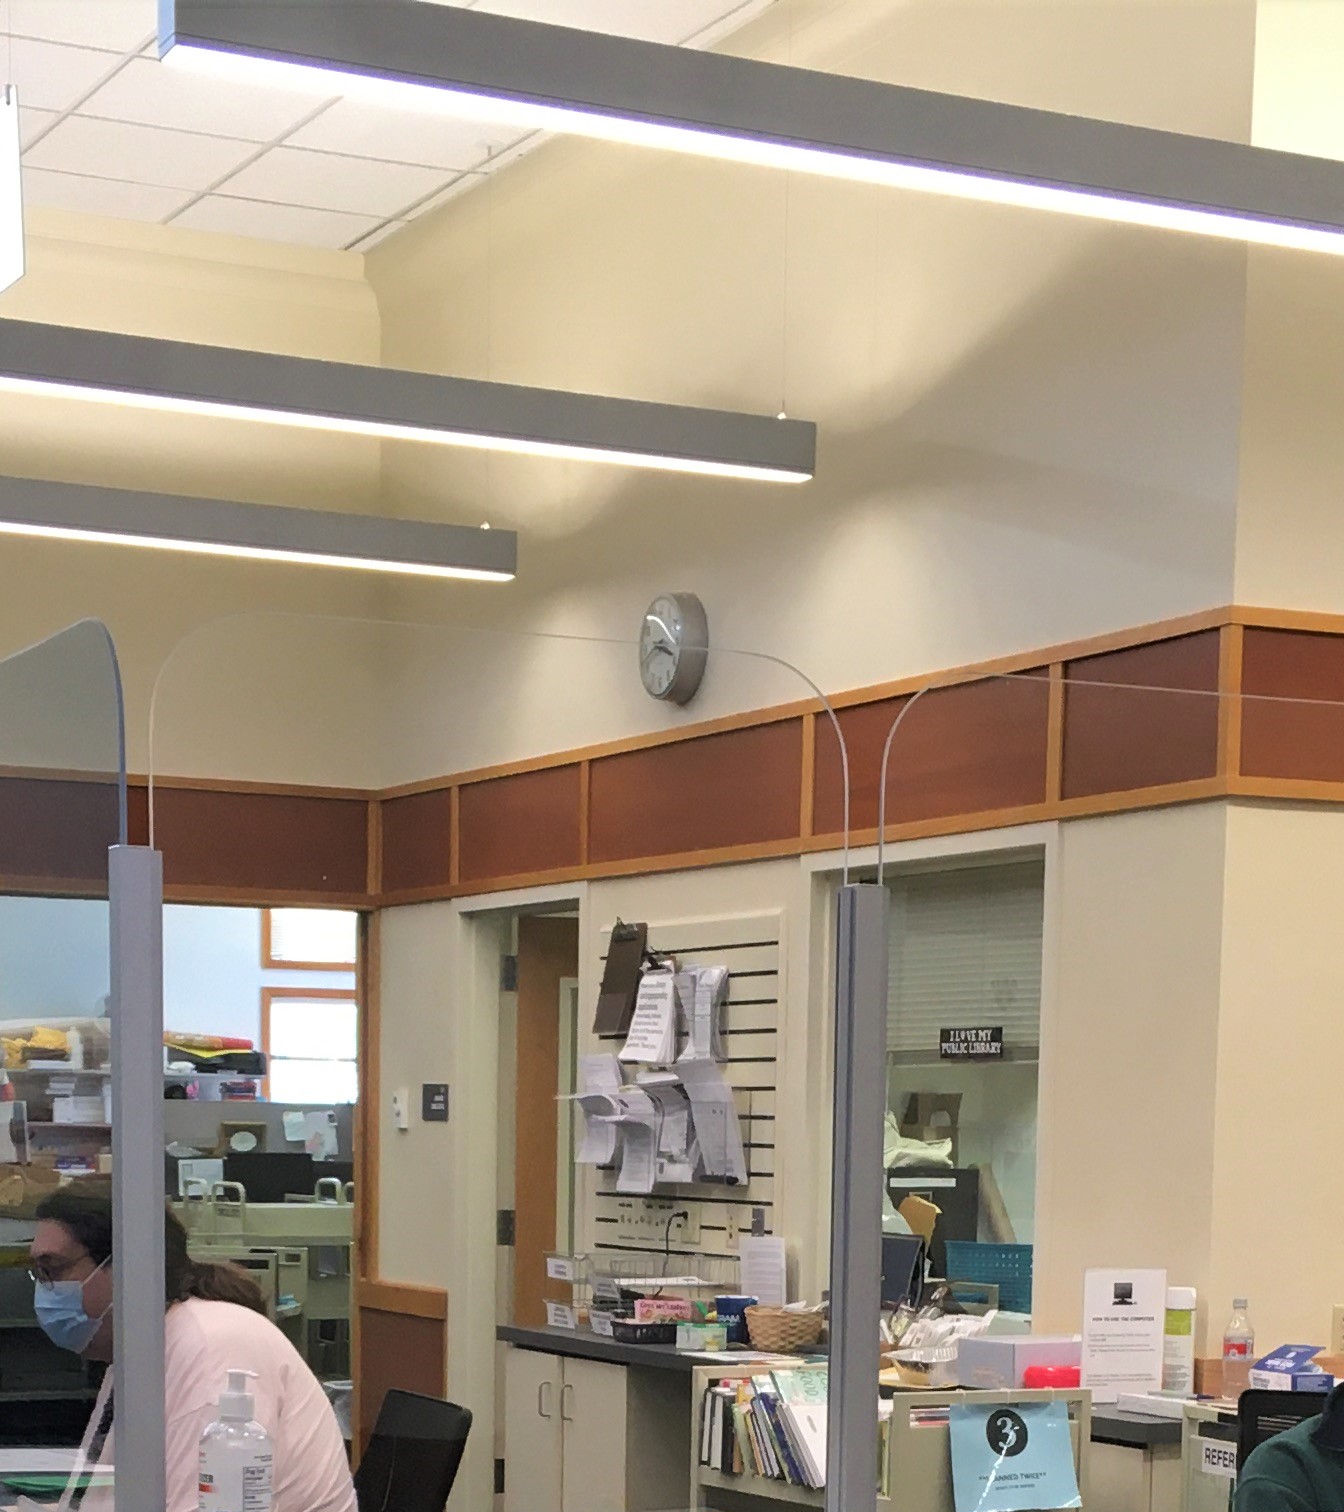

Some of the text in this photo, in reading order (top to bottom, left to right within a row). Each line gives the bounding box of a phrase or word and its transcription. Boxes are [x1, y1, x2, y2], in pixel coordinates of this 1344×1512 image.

[978, 1029, 993, 1041] MY
[941, 1041, 1002, 1053] PUBLIC LIBRARY
[996, 1416, 1017, 1448] 3
